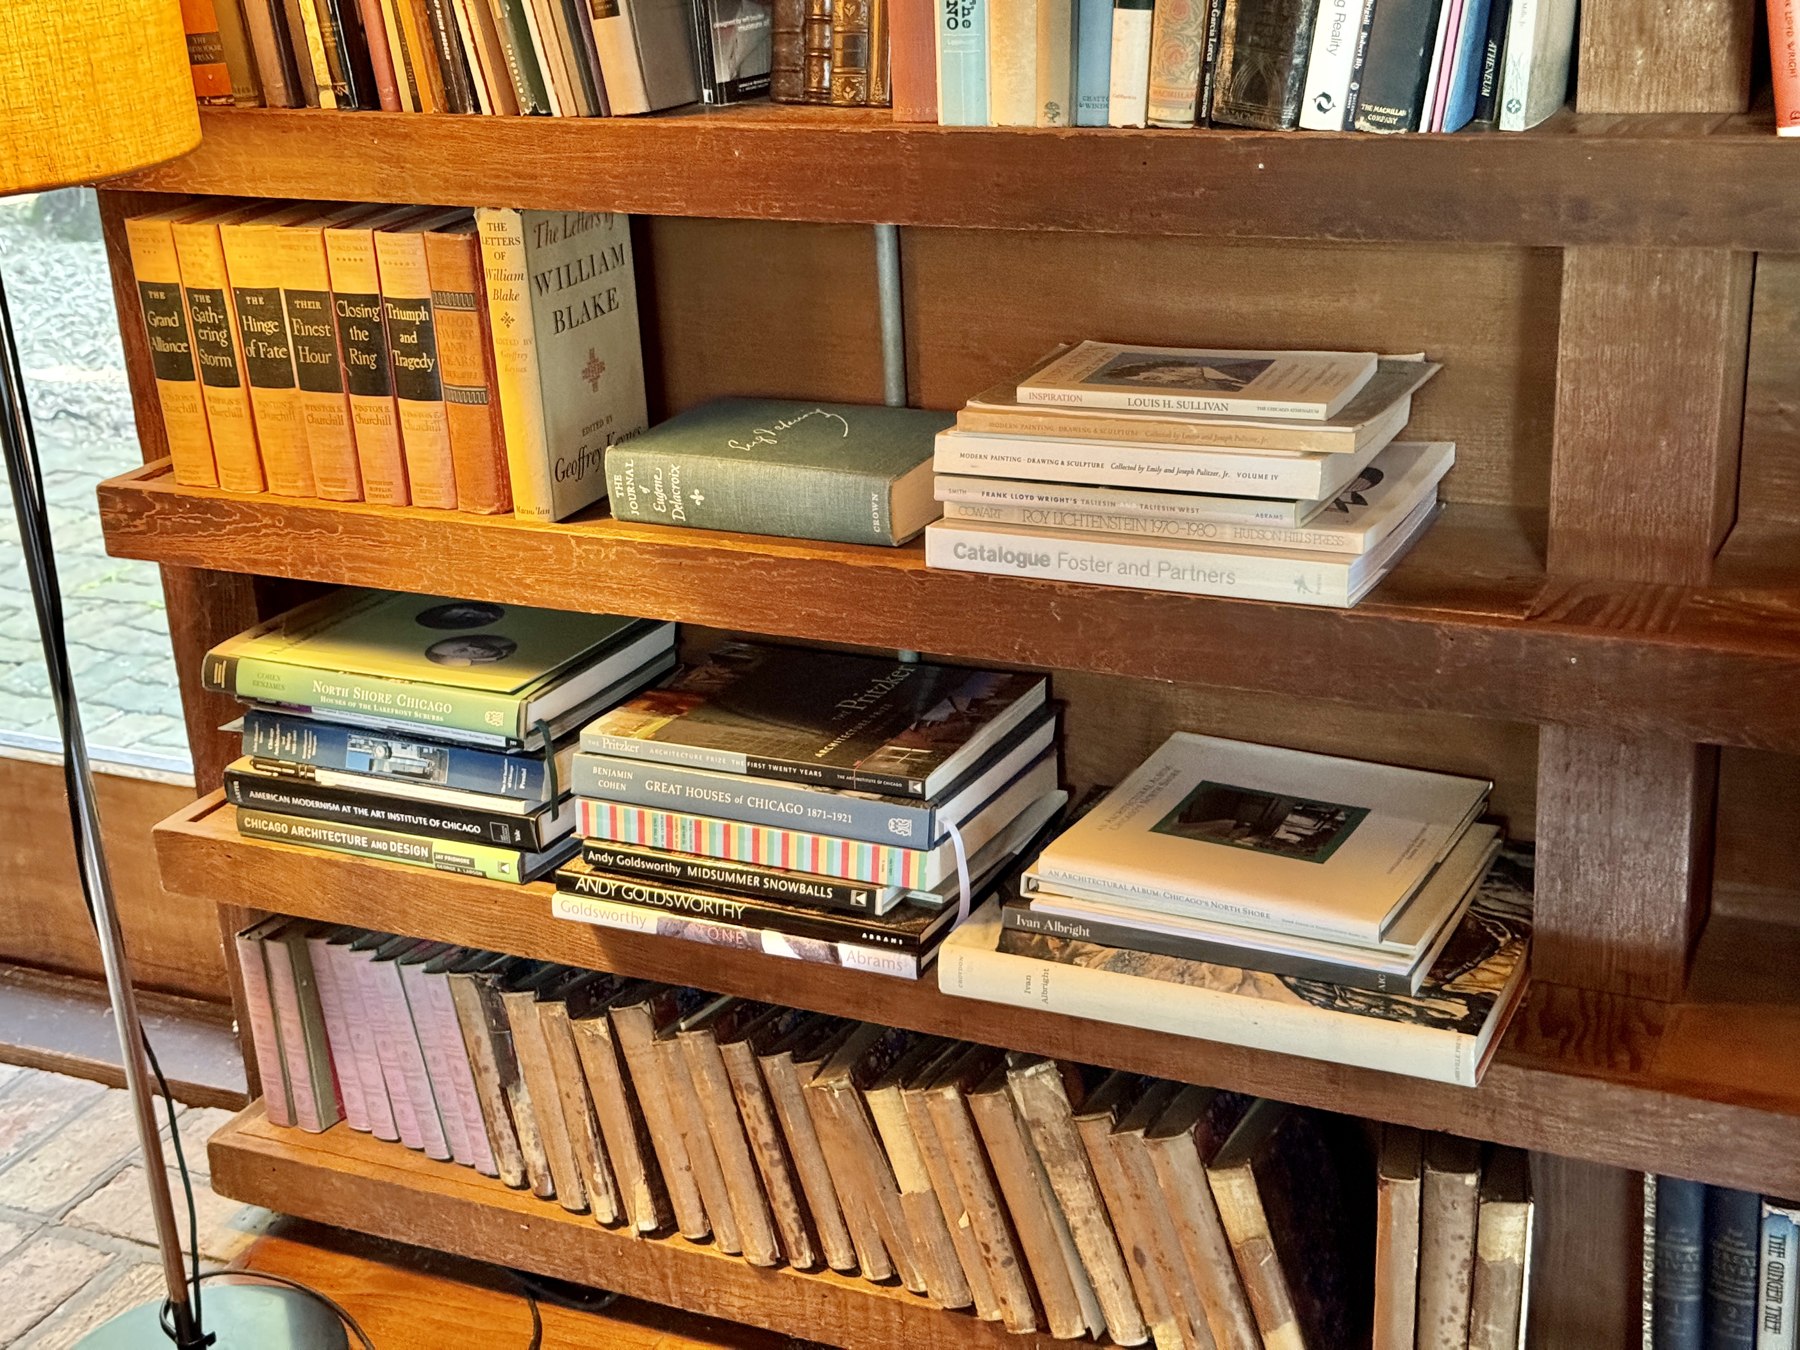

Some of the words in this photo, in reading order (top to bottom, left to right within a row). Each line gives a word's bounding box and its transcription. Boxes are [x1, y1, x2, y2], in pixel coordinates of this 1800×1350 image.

[1326, 12, 1346, 56] Reality
[1207, 38, 1217, 62] Lorca
[1786, 41, 1798, 78] WRIGHT
[1481, 40, 1498, 96] ATHENEUM
[1361, 104, 1372, 112] THE
[486, 222, 508, 232] THE
[534, 220, 560, 249] The
[563, 211, 600, 240] Letters
[482, 236, 521, 246] LETTERS
[494, 252, 506, 260] OF
[485, 268, 524, 282] William
[533, 242, 626, 297] WILLIAM
[149, 290, 166, 300] THE
[194, 294, 212, 304] THE
[246, 296, 264, 305] THE
[294, 300, 322, 310] THEIR
[492, 288, 520, 302] Blake
[148, 310, 179, 328] Grand
[192, 306, 224, 324] Gath-
[336, 300, 381, 322] Closing
[385, 302, 430, 325] Triumph
[552, 287, 620, 335] BLAKE
[242, 315, 280, 336] Hinge
[292, 318, 332, 337] Finest
[350, 326, 370, 341] the
[150, 336, 188, 353] Alliance
[198, 327, 228, 348] ering
[246, 339, 257, 358] of
[258, 342, 288, 359] Fate
[400, 331, 418, 344] and
[200, 348, 232, 368] Storm
[298, 346, 332, 364] Hour
[349, 348, 378, 370] Ring
[392, 350, 436, 372] Tragedy
[1028, 392, 1083, 402] INSPIRATION
[1127, 398, 1160, 408] LOUIS
[1162, 399, 1174, 410] H.
[1176, 400, 1230, 412] SULLIVAN
[306, 414, 344, 426] Churchill
[355, 414, 392, 426] Churchill
[582, 418, 604, 437] EDITED
[605, 414, 613, 425] BY
[554, 444, 602, 483] Geoffrey
[960, 452, 988, 460] MODERN
[990, 454, 1022, 462] PAINTING
[1026, 457, 1060, 466] DRAWING
[1066, 460, 1104, 469] SCULPTURE
[1110, 462, 1136, 472] Collected
[1137, 464, 1145, 474] by
[1146, 466, 1162, 475] Emily
[1164, 466, 1174, 474] and
[1176, 466, 1195, 476] Joseph
[1222, 470, 1230, 480] Jr.
[1237, 472, 1268, 481] VOLUME
[1270, 474, 1279, 482] IV
[614, 474, 625, 498] THE
[625, 458, 640, 516] JOURNAL
[652, 467, 668, 513] Eugene
[668, 464, 686, 522] Delacroix
[982, 490, 1008, 498] FRANK
[1037, 494, 1077, 504] WRIGHT'S
[1080, 499, 1116, 507] TALIESIN
[1140, 503, 1175, 512] TALIESIN
[1176, 506, 1200, 514] WEST
[1256, 512, 1284, 520] ABRAMS
[958, 505, 1002, 518] COWART
[1022, 509, 1050, 524] ROY
[1053, 510, 1148, 533] LICHTENSTEIN
[1233, 527, 1282, 540] HUDSON
[1284, 530, 1312, 544] HILLS
[1312, 534, 1344, 546] PRESS
[953, 542, 1050, 568] Catalogue
[1058, 552, 1113, 574] Foster
[1118, 558, 1150, 576] and
[1158, 560, 1236, 584] Partners
[312, 680, 349, 698] NORTH
[353, 686, 392, 705] SHORE
[396, 694, 452, 714] CHICAGO
[320, 696, 346, 706] HOUSES
[359, 702, 372, 712] THE
[374, 704, 412, 718] LAKEFRONT
[414, 710, 444, 722] SUBURBS
[602, 736, 640, 754] Pritzker
[650, 748, 703, 761] ARCHITECTURE
[706, 756, 726, 764] PRIZE
[731, 759, 745, 767] THE
[747, 762, 766, 770] FIRST
[768, 765, 798, 774] TWENTY
[800, 768, 823, 778] YEARS
[592, 766, 634, 780] BENJAMIN
[598, 779, 627, 792] COHEN
[644, 780, 682, 796] GREAT
[685, 786, 732, 804] HOUSES
[734, 795, 744, 805] of
[746, 796, 804, 816] CHICAGO
[250, 790, 290, 804] AMERICAN
[292, 797, 340, 812] MODERNISM
[342, 804, 352, 814] AT
[353, 807, 369, 816] THE
[370, 810, 386, 819] ART
[387, 812, 428, 826] INSTITUTE
[430, 818, 440, 828] OF
[442, 820, 482, 834] CHICAGO
[244, 817, 289, 834] CHICAGO
[290, 825, 368, 848] ARCHITECTURE
[370, 840, 388, 851] AND
[389, 841, 429, 858] DESIGN
[588, 850, 614, 866] Andy
[616, 854, 682, 876] Goldsworthy
[687, 865, 760, 888] MIDSUMMER
[763, 878, 833, 899] SNOWBALLS
[1062, 871, 1128, 892] ARCHITECTURAL
[1211, 901, 1241, 914] NORTH
[1242, 906, 1271, 920] SHORE
[575, 876, 618, 898] ANDY
[621, 886, 746, 920] GOLDSWORTHY
[862, 932, 904, 946] ABRAMS
[560, 900, 647, 930] Goldsworthy
[846, 950, 903, 972] Abrams
[1016, 914, 1040, 929] Ivan
[1043, 919, 1090, 938] Albright
[1024, 974, 1032, 994] Ivan
[1041, 968, 1050, 1004] Albright
[1378, 974, 1386, 992] AIC
[1768, 1234, 1786, 1259] THE
[1766, 1260, 1786, 1304] GINGER
[1764, 1306, 1783, 1336] TREE
